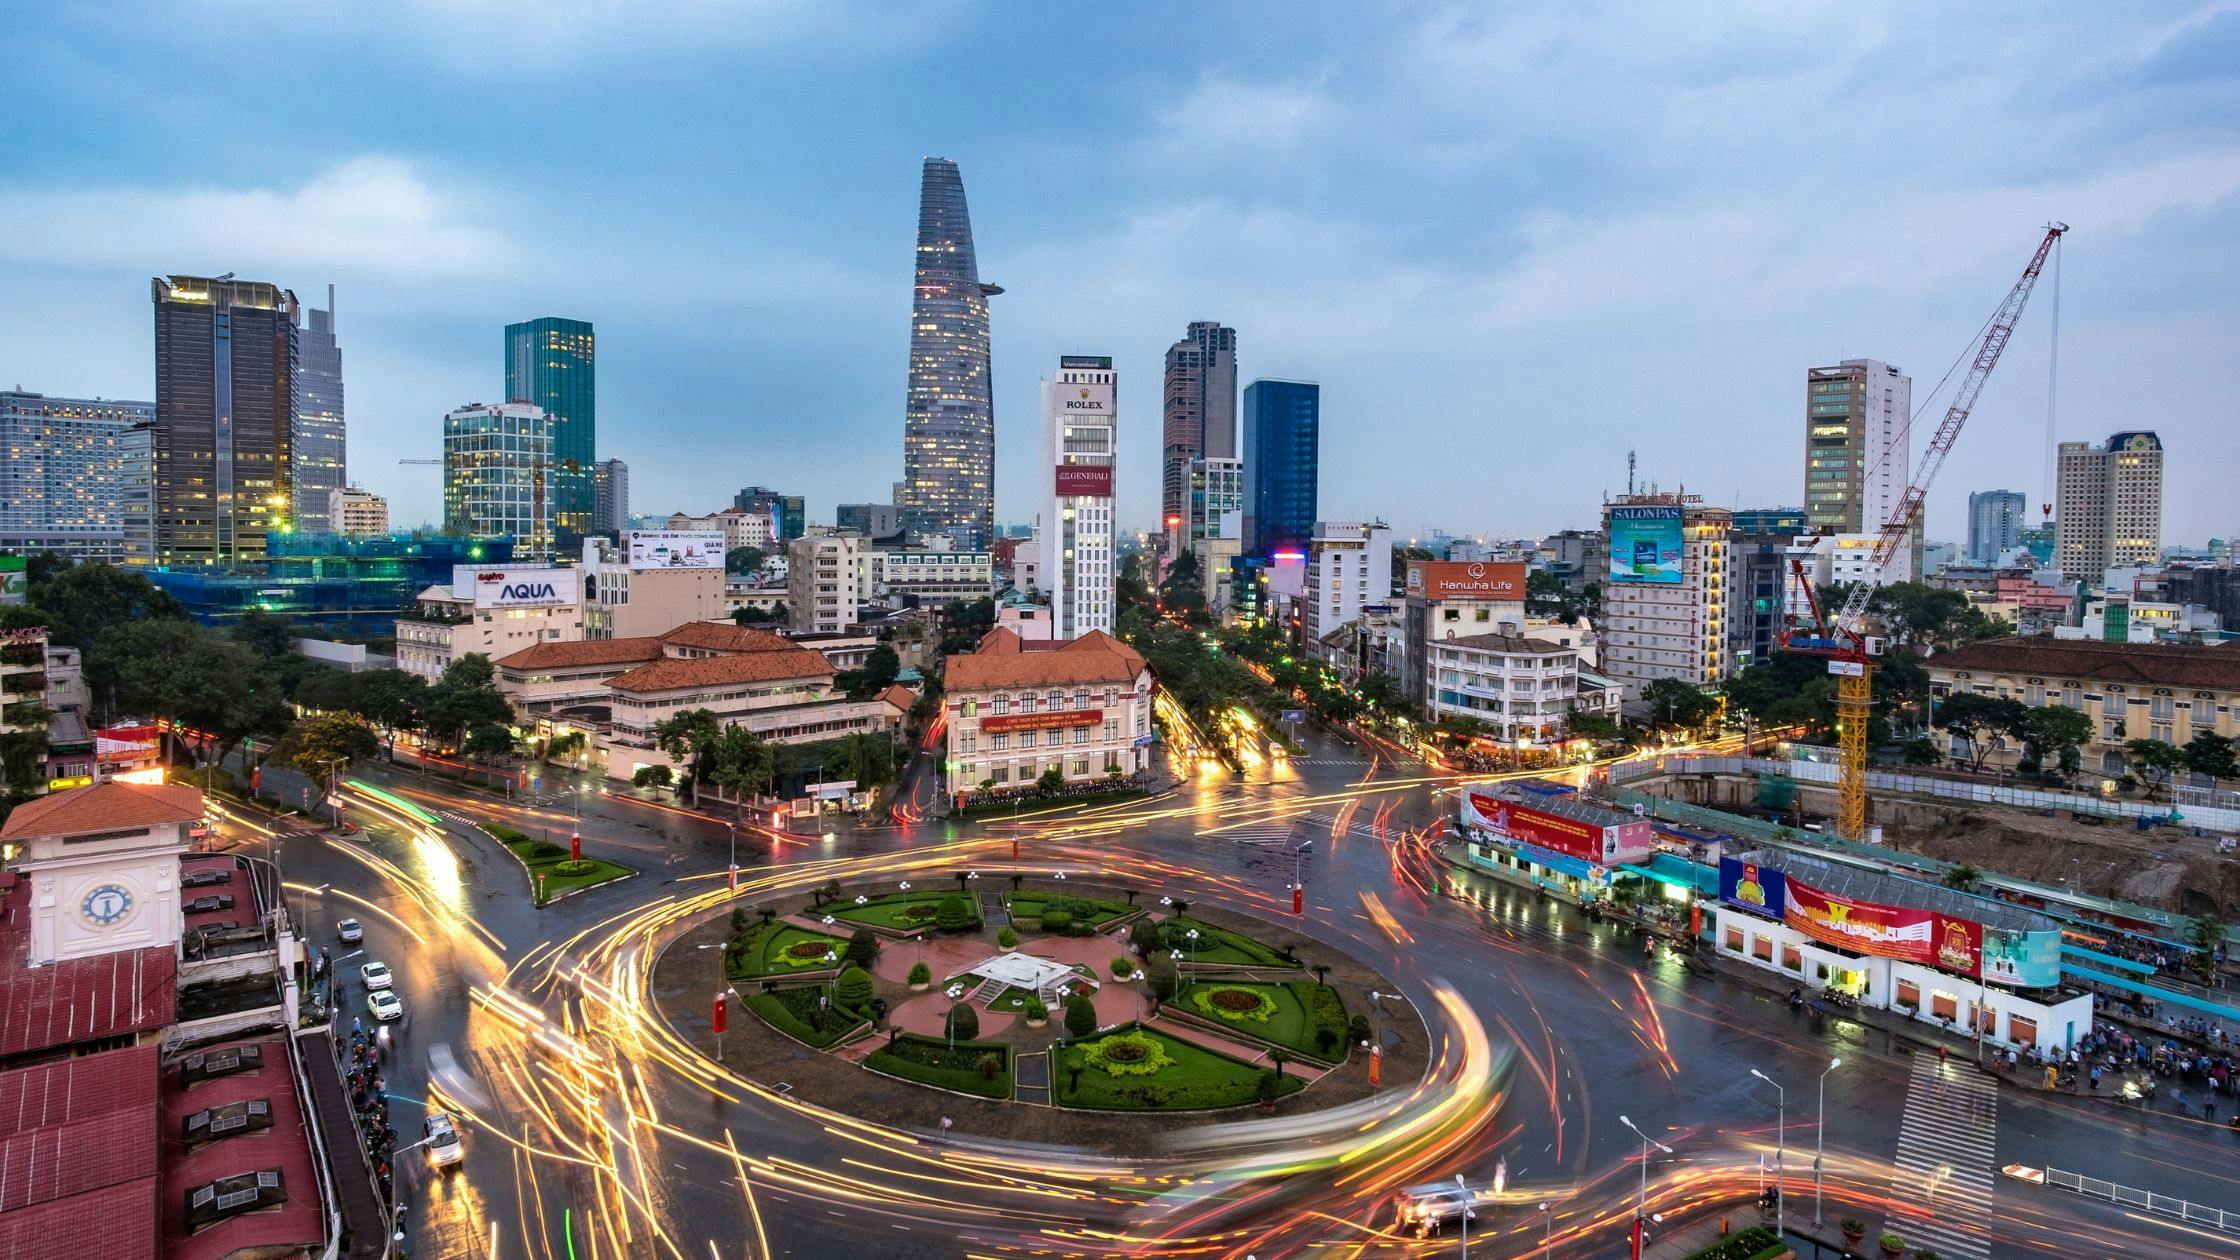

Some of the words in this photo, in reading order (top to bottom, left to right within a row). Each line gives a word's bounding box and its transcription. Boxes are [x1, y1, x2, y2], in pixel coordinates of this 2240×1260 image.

[1066, 401, 1103, 409] ROLEX
[1070, 472, 1108, 480] GENERALI
[1677, 495, 1703, 503] HOTEL
[1615, 508, 1680, 519] SALONPAS
[1440, 580, 1489, 590] Hanwha
[1491, 580, 1513, 590] Life
[500, 583, 556, 599] AQUA
